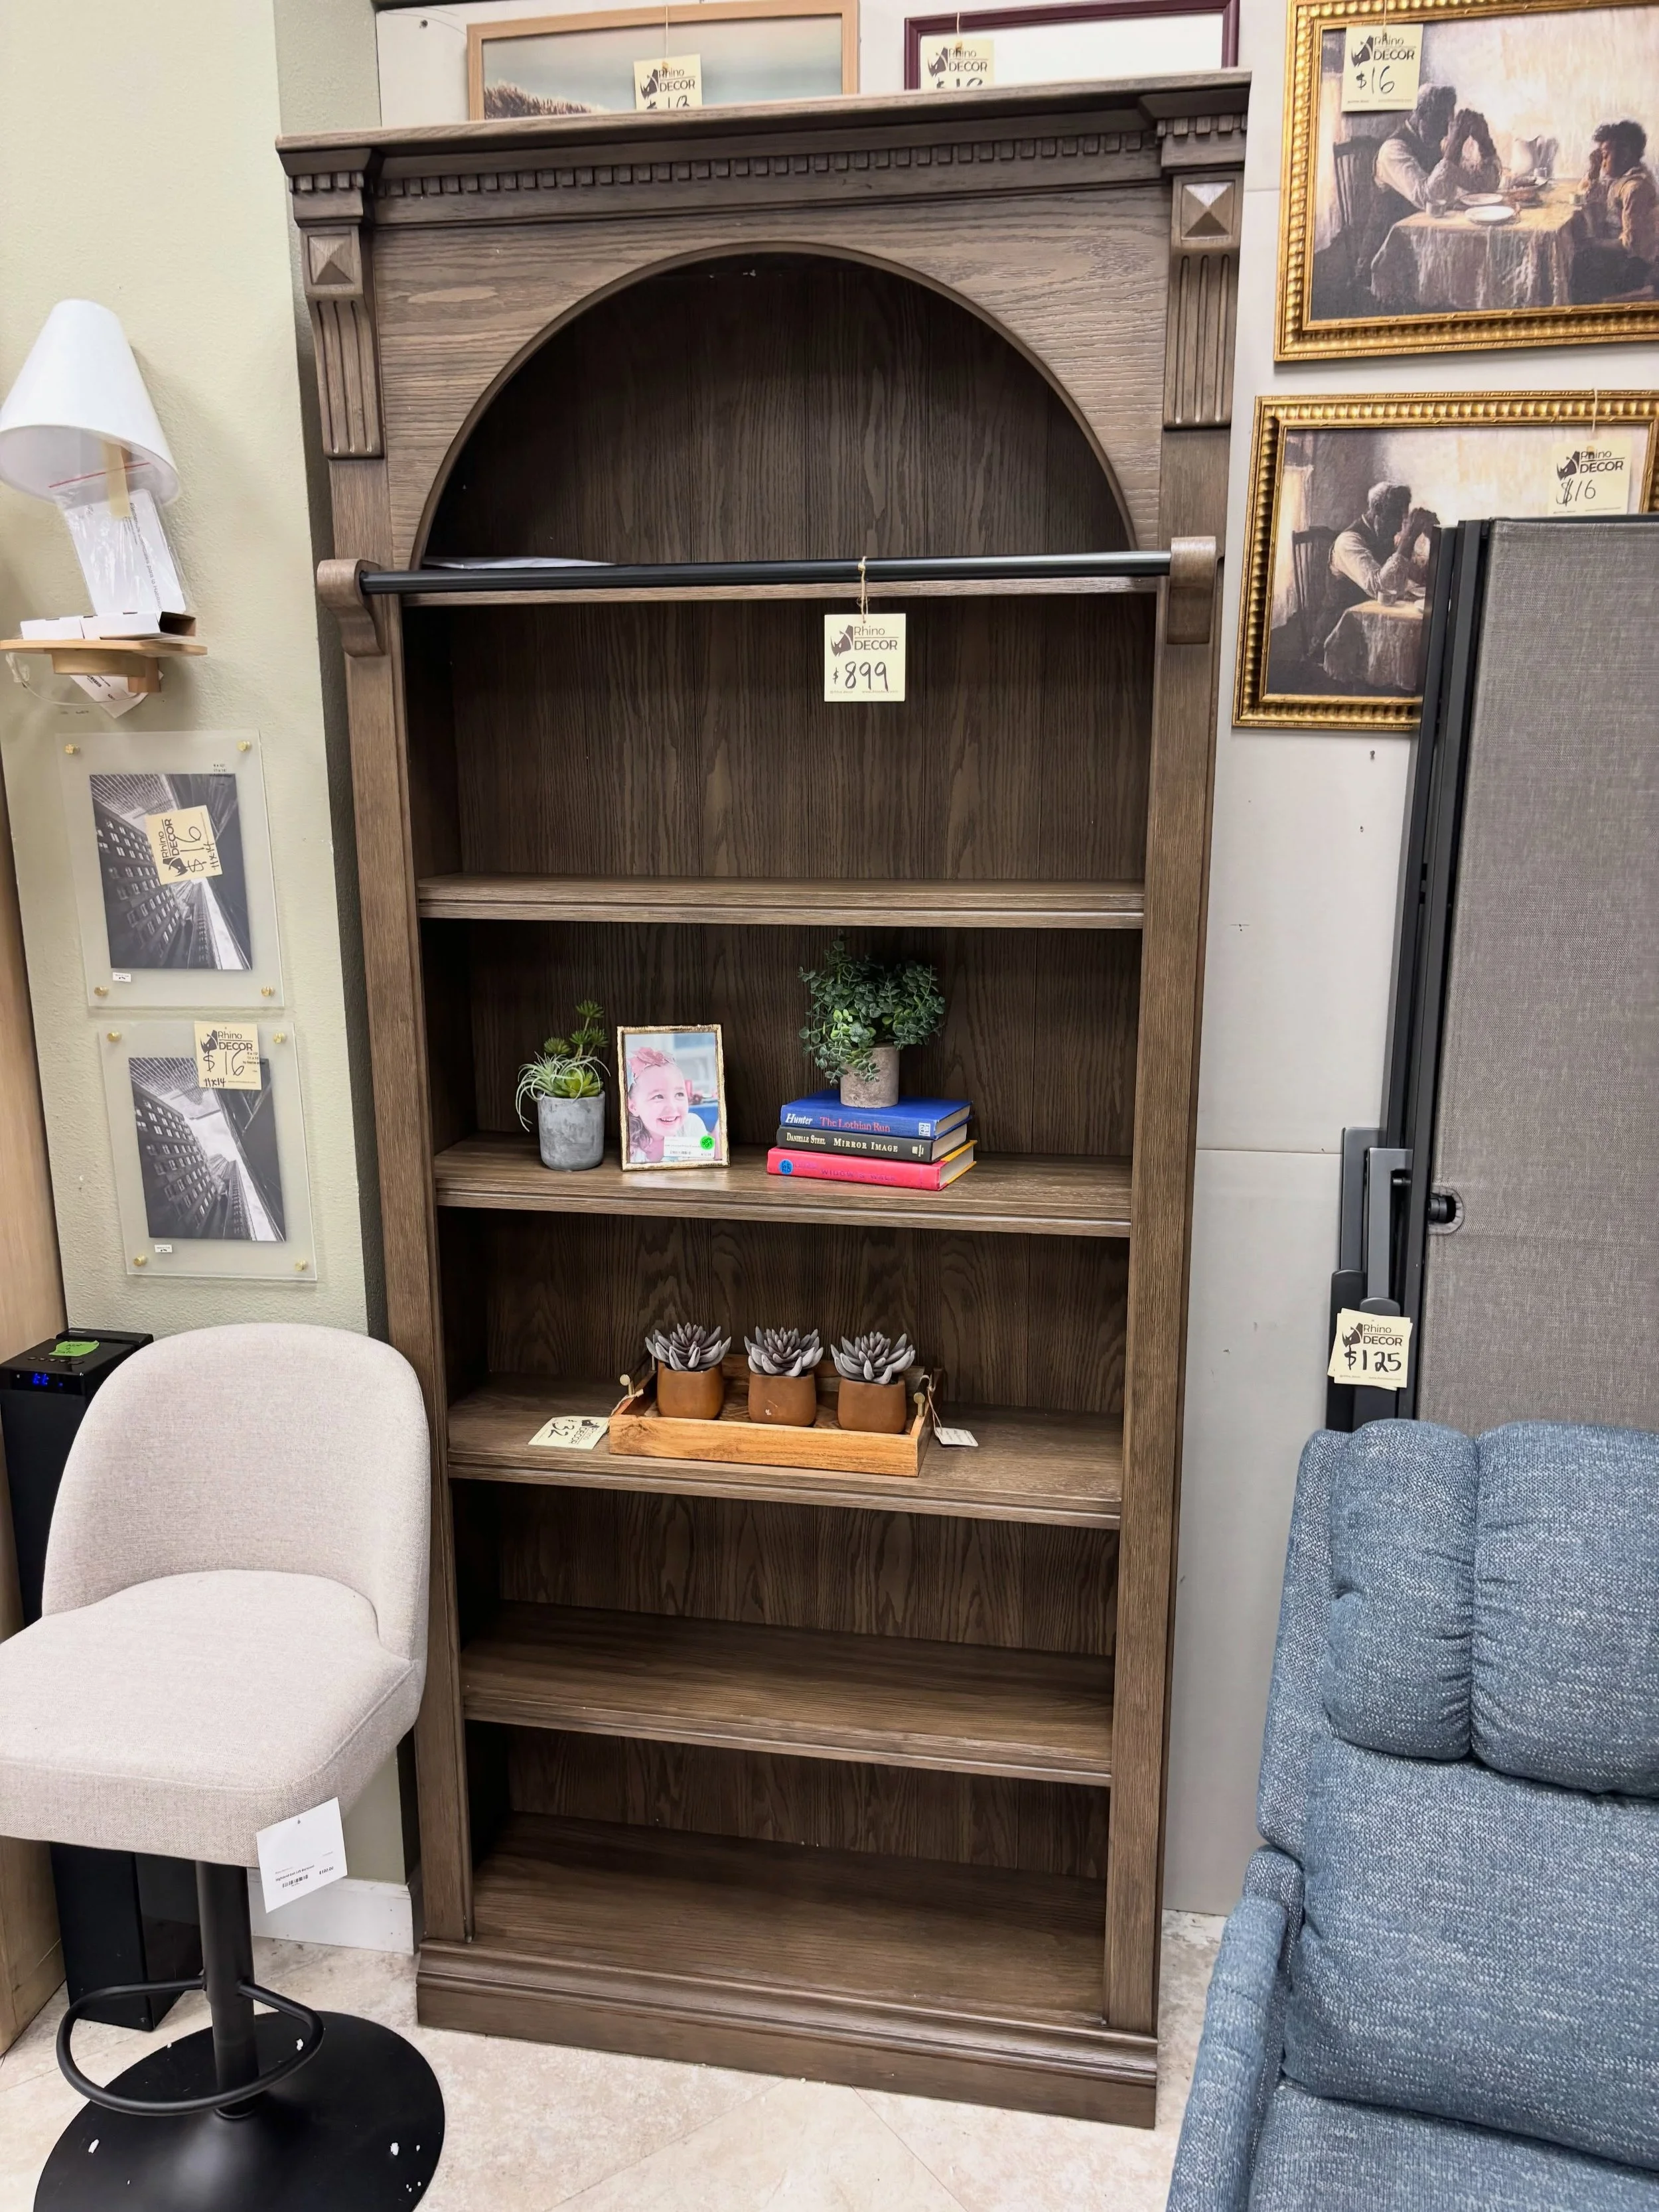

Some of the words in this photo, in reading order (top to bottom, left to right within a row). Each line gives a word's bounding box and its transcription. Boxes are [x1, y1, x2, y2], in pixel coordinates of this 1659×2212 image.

[1374, 34, 1405, 45] Rhino
[1374, 49, 1415, 61] DECOR
[949, 61, 988, 72] DECOR
[660, 79, 695, 92] DECOR
[1356, 65, 1395, 94] $16
[1581, 449, 1613, 460] Rhino
[1580, 461, 1624, 474] DECOR
[1556, 478, 1596, 506] $16
[854, 625, 885, 636] Rhino
[854, 640, 897, 650] DECOR
[833, 661, 889, 692] $899
[164, 818, 180, 856] DECOR
[159, 831, 169, 858] Rhino
[173, 826, 207, 873] $16
[218, 1031, 242, 1039] Rhino
[219, 1042, 253, 1051] DECOR
[202, 1050, 244, 1076] $16
[204, 1078, 226, 1087] 11x14
[785, 1113, 813, 1125] Hunter
[820, 1116, 837, 1126] The
[838, 1118, 871, 1130] Lothian
[873, 1122, 891, 1132] Run
[786, 1132, 809, 1143] DANIELLE
[810, 1135, 826, 1145] STEEL
[833, 1138, 867, 1149] MIRROR
[871, 1142, 899, 1152] IMAGE
[1364, 1323, 1392, 1333] Rhino
[1363, 1335, 1403, 1347] DECOR
[1344, 1345, 1402, 1372] $125
